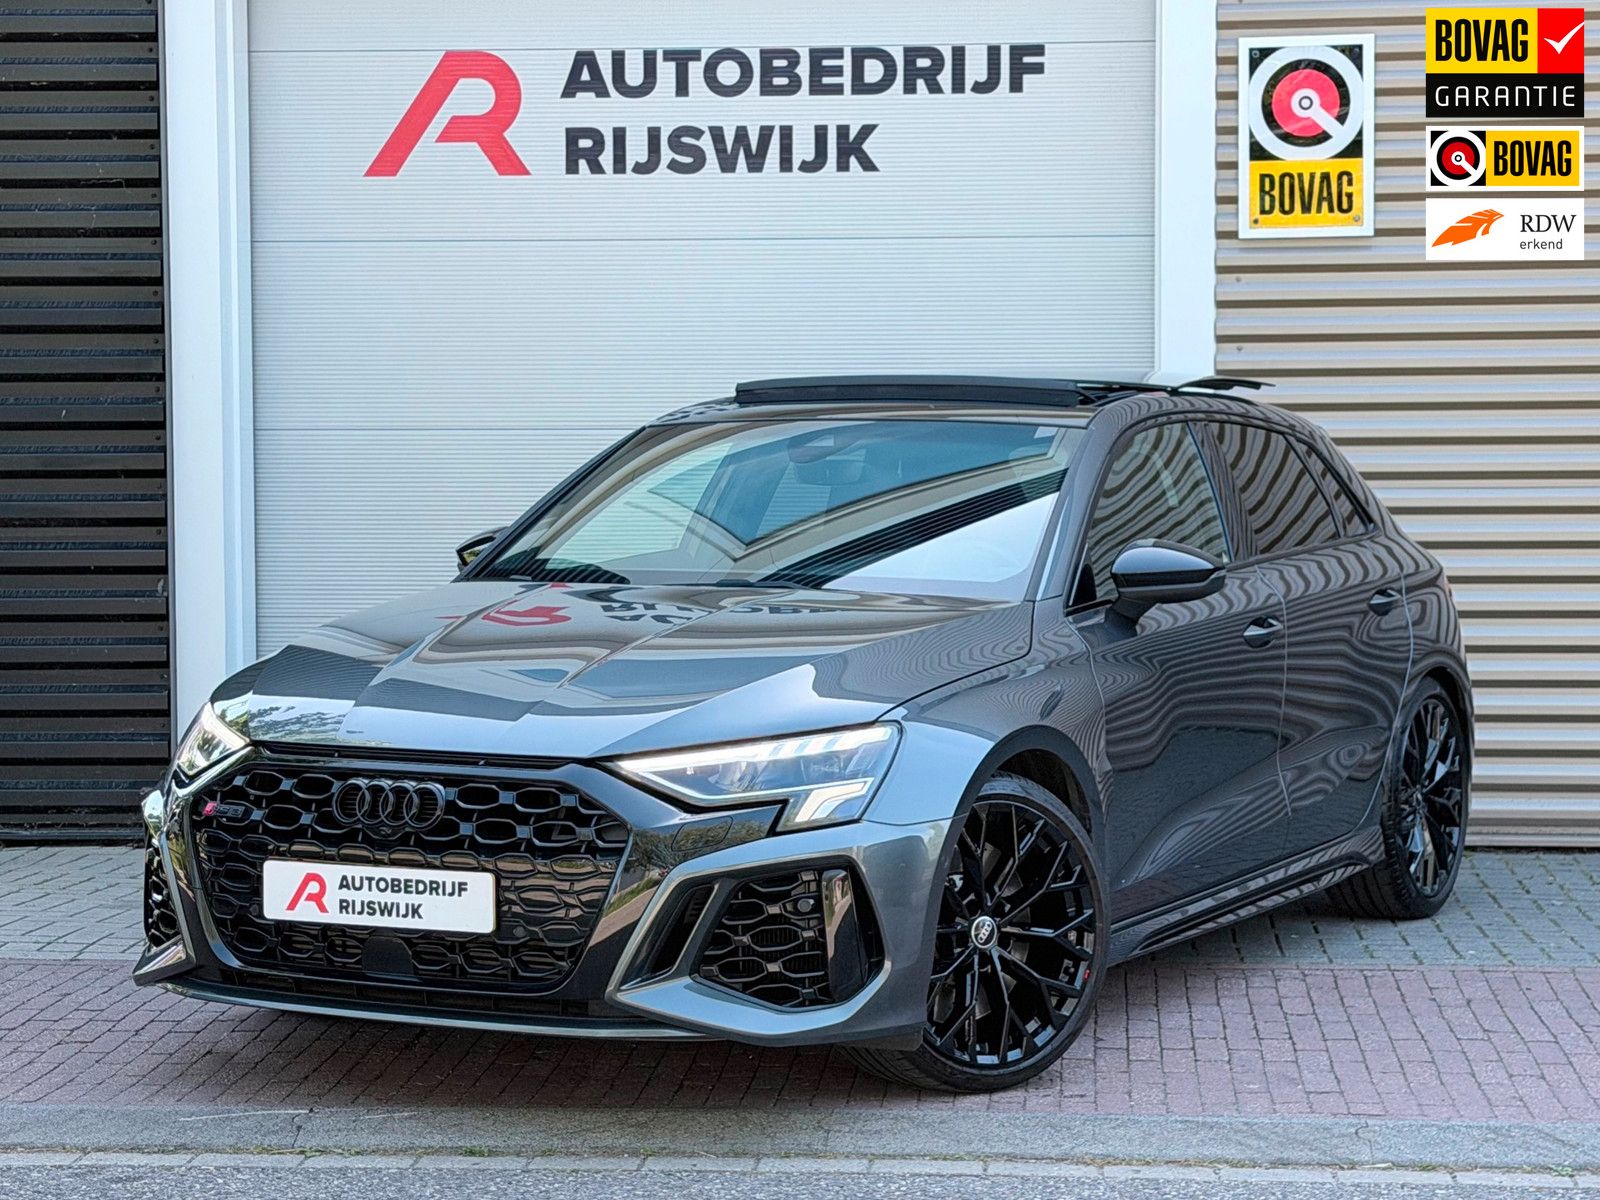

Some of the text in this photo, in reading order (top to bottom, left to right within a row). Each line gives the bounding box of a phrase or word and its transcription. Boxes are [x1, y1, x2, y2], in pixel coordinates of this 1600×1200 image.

[560, 44, 1046, 99] AUTOBEDRIJF
[565, 123, 880, 175] RIJSWIJK
[1259, 170, 1354, 216] BOVAG
[338, 874, 469, 898] AUTOBEDRIJF
[338, 898, 424, 920] RIJSWIJK
